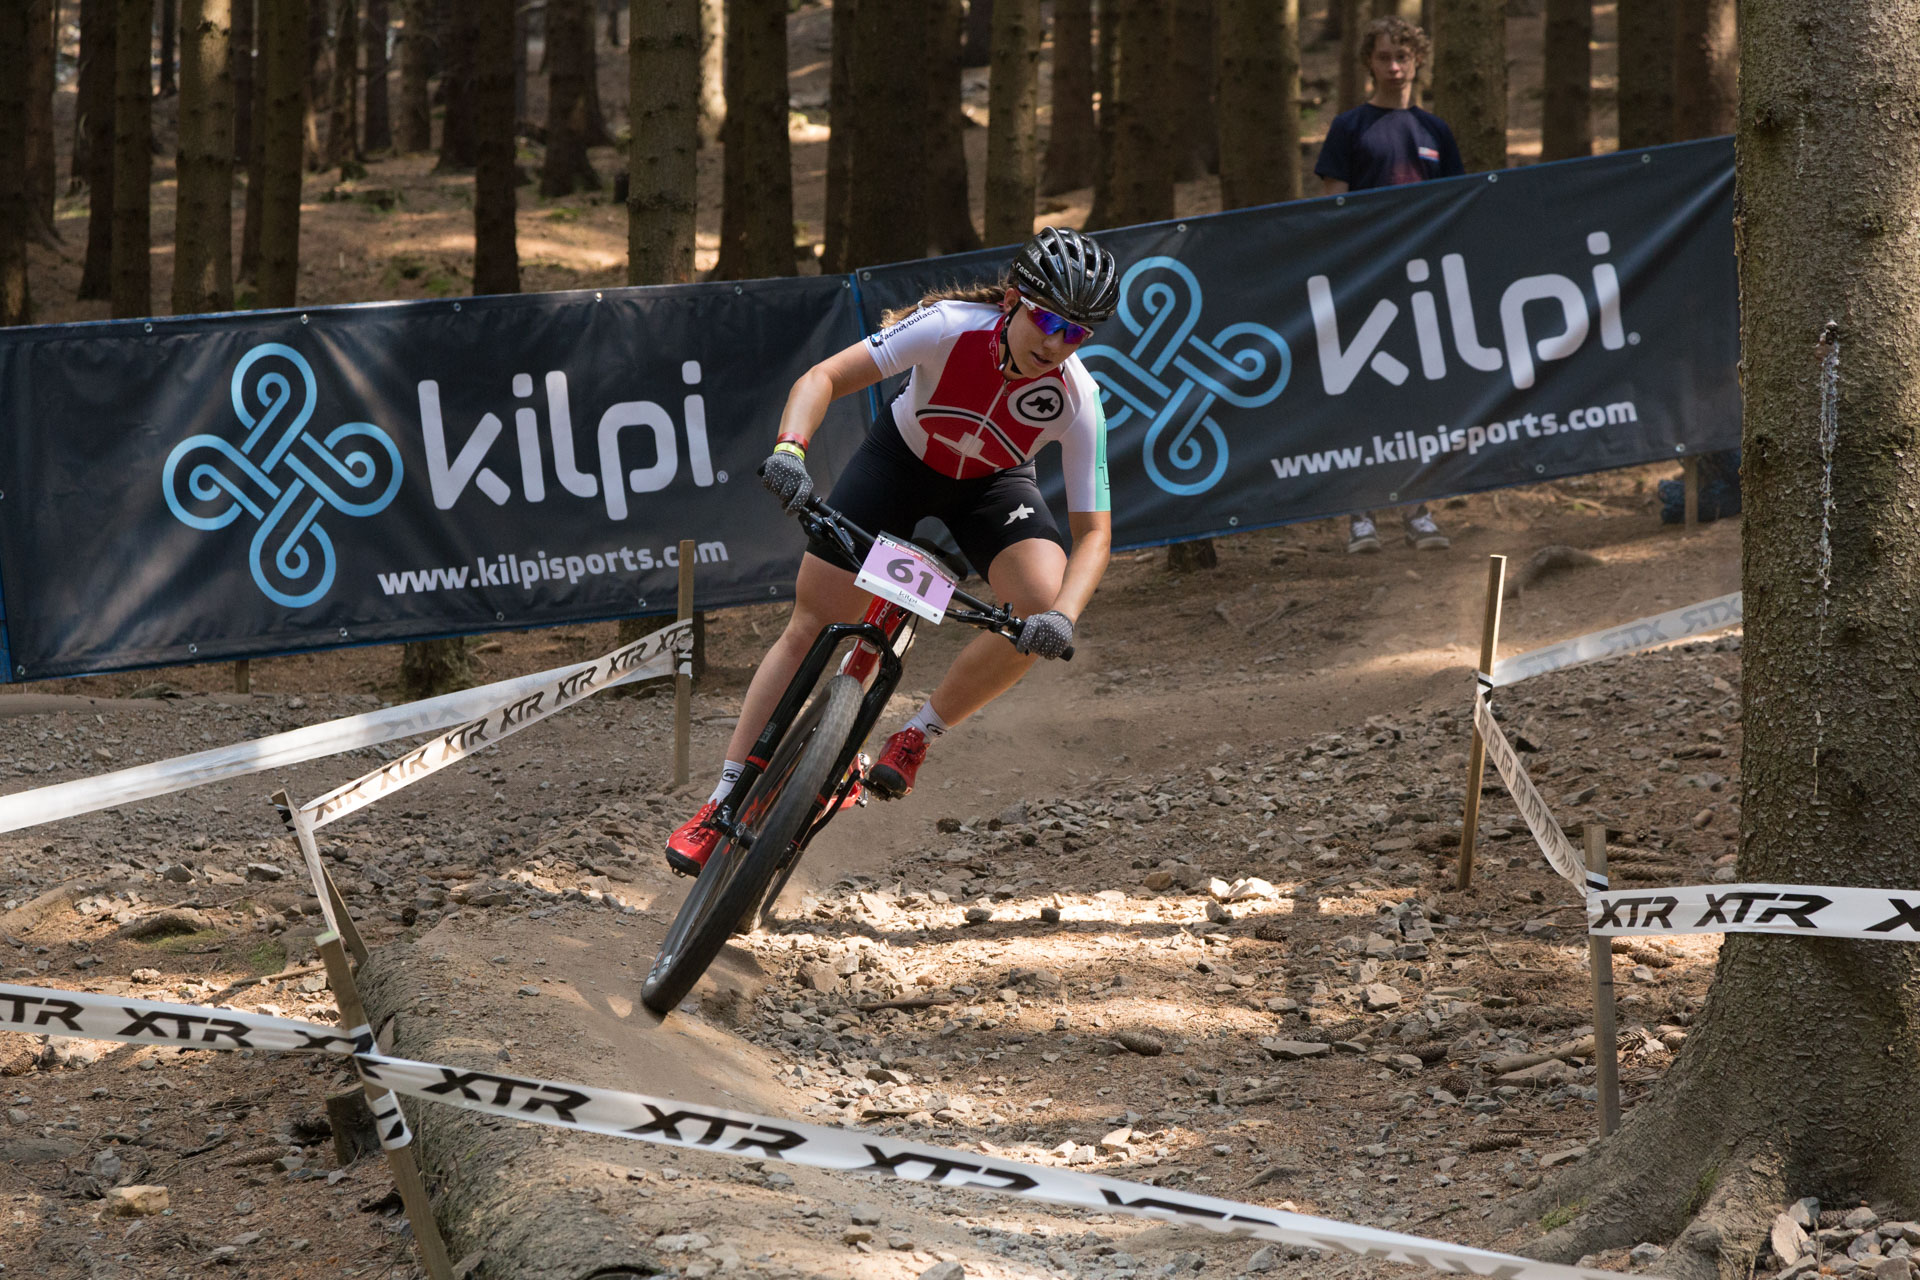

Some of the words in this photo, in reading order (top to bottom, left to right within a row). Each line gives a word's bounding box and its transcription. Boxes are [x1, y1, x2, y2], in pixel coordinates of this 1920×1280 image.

[1307, 231, 1625, 395] kilpi
[417, 360, 714, 521] kilpi
[1271, 401, 1638, 479] www.kilpisports.com
[377, 541, 729, 595] www.kilpisports.cm
[887, 558, 934, 598] 61
[442, 717, 490, 761] XTR
[500, 691, 546, 732] XTR
[555, 665, 598, 706] XTR
[607, 642, 648, 680] XTR
[1592, 895, 1679, 930] XTR
[1694, 892, 1834, 929] XTR
[0, 993, 85, 1031] TR
[117, 1007, 254, 1047] XTR
[421, 1068, 591, 1123] XTR
[620, 1103, 808, 1159] XTR
